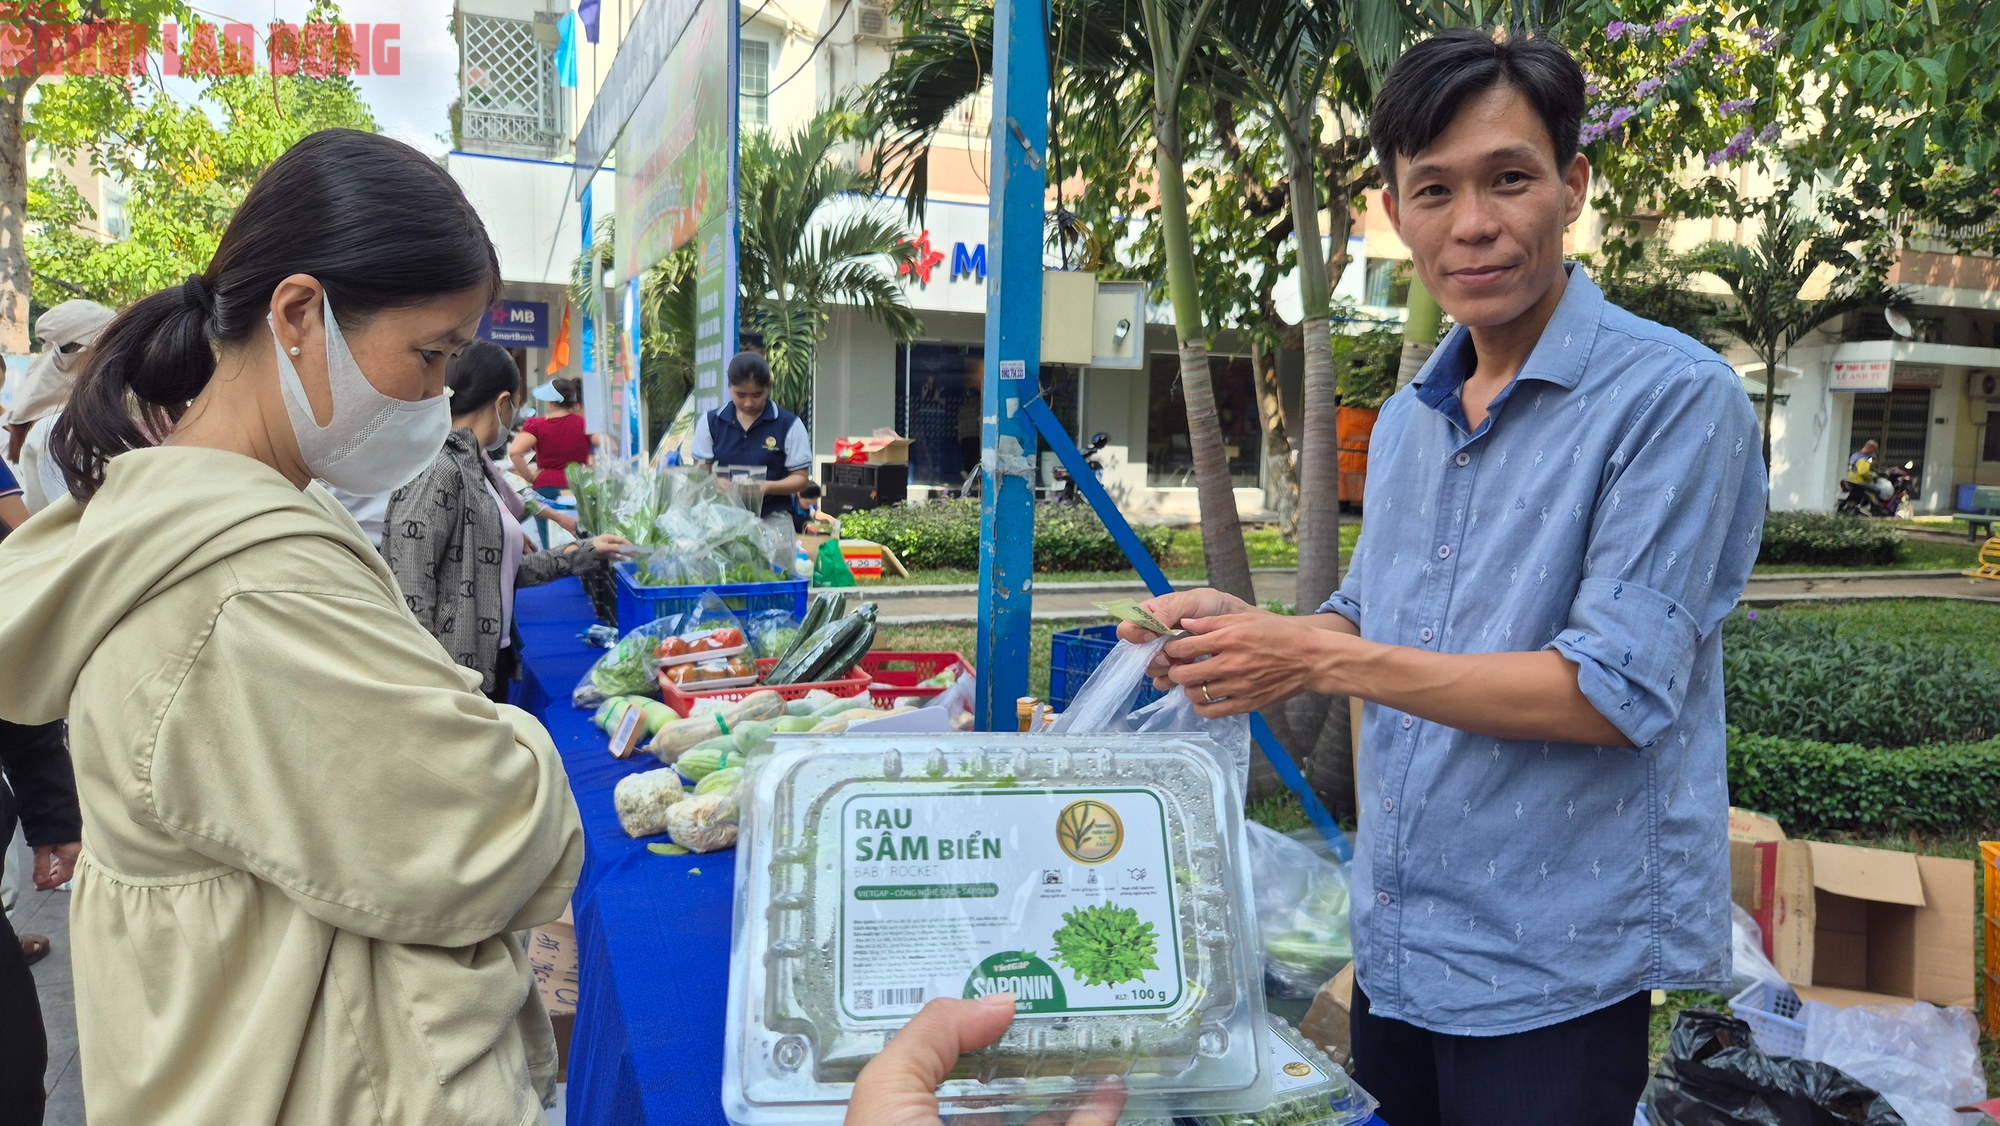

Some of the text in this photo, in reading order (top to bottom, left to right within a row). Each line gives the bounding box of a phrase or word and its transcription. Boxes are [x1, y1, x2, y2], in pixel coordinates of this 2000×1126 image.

[952, 242, 987, 279] M
[510, 308, 535, 324] MB
[490, 331, 535, 342] SmartBank
[855, 808, 913, 829] RAU
[855, 830, 1002, 862] SÂM BIỂN
[854, 865, 939, 878] BABY ROCKET
[858, 889, 889, 898] VIETGAP
[895, 887, 917, 897] CÔNG
[962, 887, 995, 895] SAPONIN
[992, 961, 1030, 973] VietGAP
[972, 975, 1054, 1000] SAPONIN
[1131, 989, 1155, 1000] 100
[1158, 991, 1166, 1002] g
